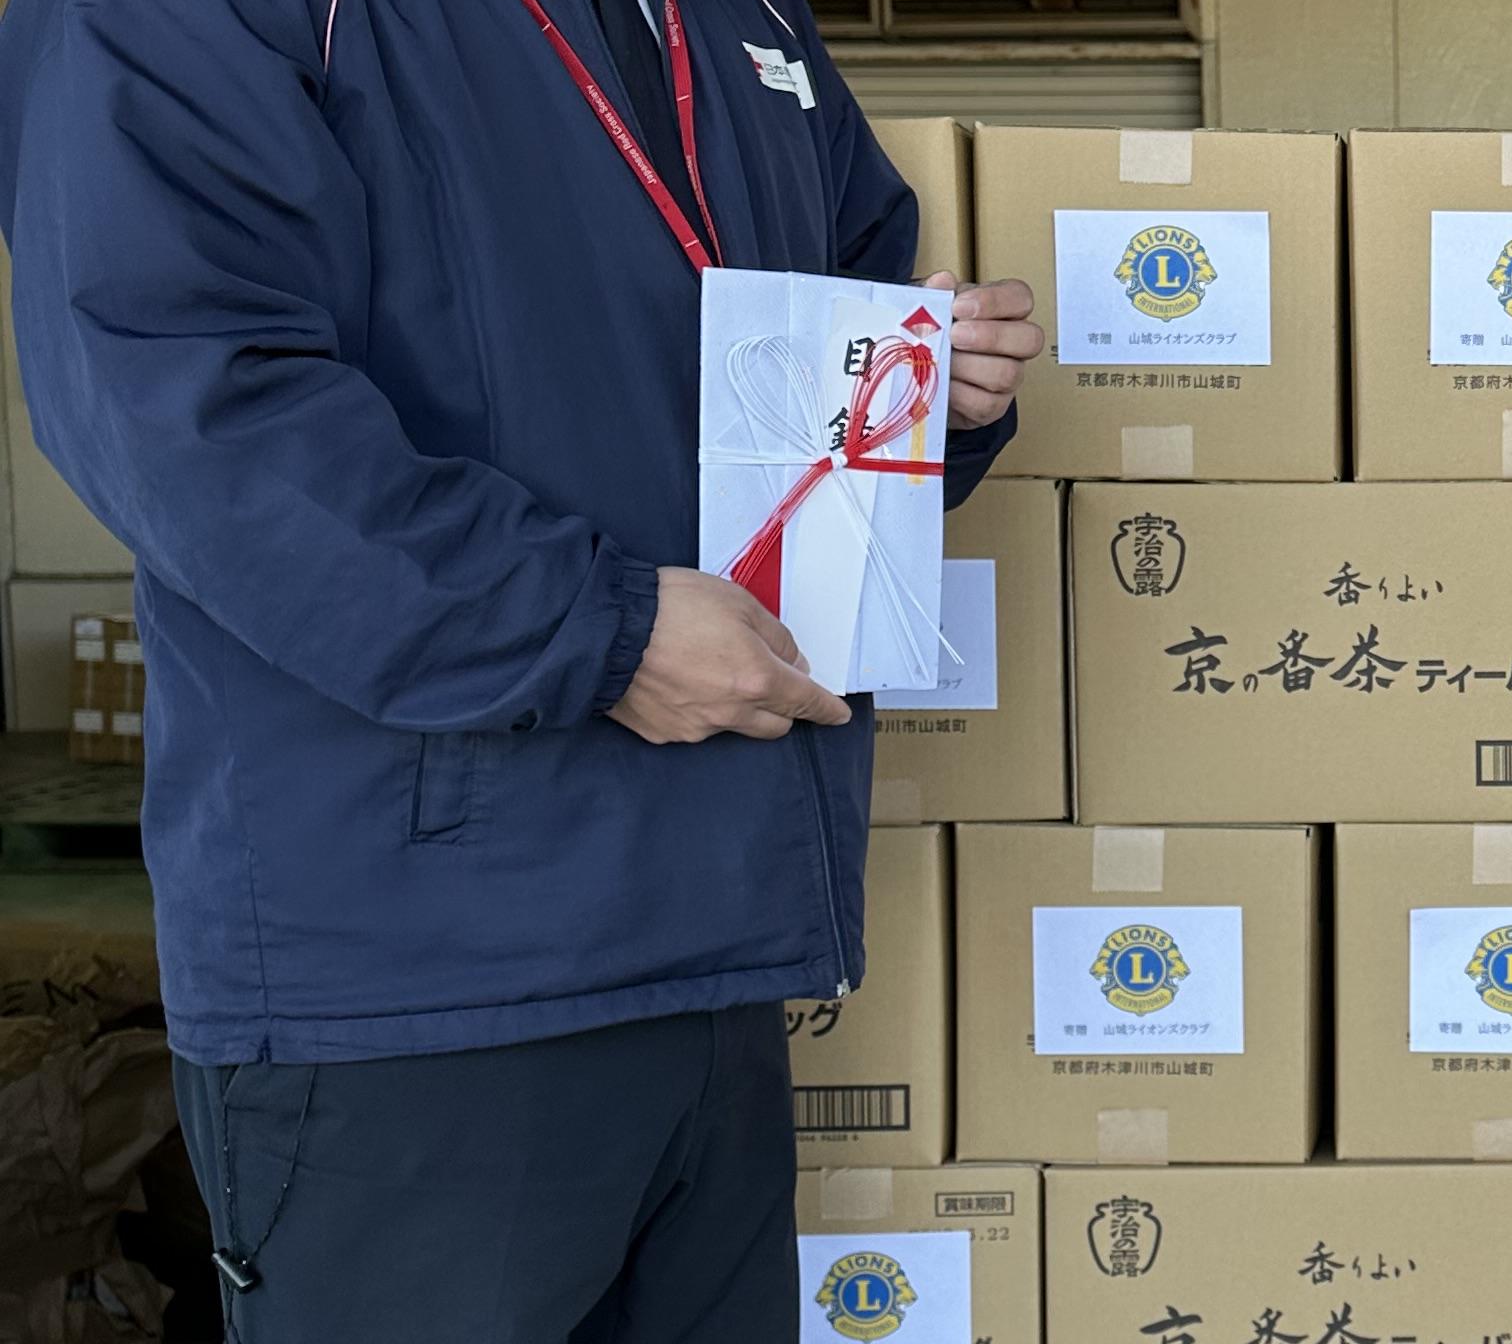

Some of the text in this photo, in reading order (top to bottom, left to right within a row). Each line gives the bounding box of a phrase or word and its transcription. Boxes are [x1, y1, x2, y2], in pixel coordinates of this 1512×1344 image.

[583, 83, 659, 187] Japanese Red Cross Society
[1136, 229, 1195, 252] LIONS
[1155, 256, 1181, 288] L
[1128, 333, 1237, 345] 山城ライオンズクラブ
[1076, 372, 1242, 389] 京都府木津川市山城町
[1133, 512, 1165, 597] 宇治の露
[1323, 561, 1444, 607] 香りよい
[1110, 928, 1168, 948] LIONS
[1128, 953, 1155, 984] L
[1052, 1060, 1214, 1077] 京都府木津川市山城町
[1109, 1195, 1141, 1278] 宇治の露
[839, 1256, 894, 1276] LIONS
[1297, 1240, 1417, 1286] 香りよい
[855, 1280, 881, 1311] L
